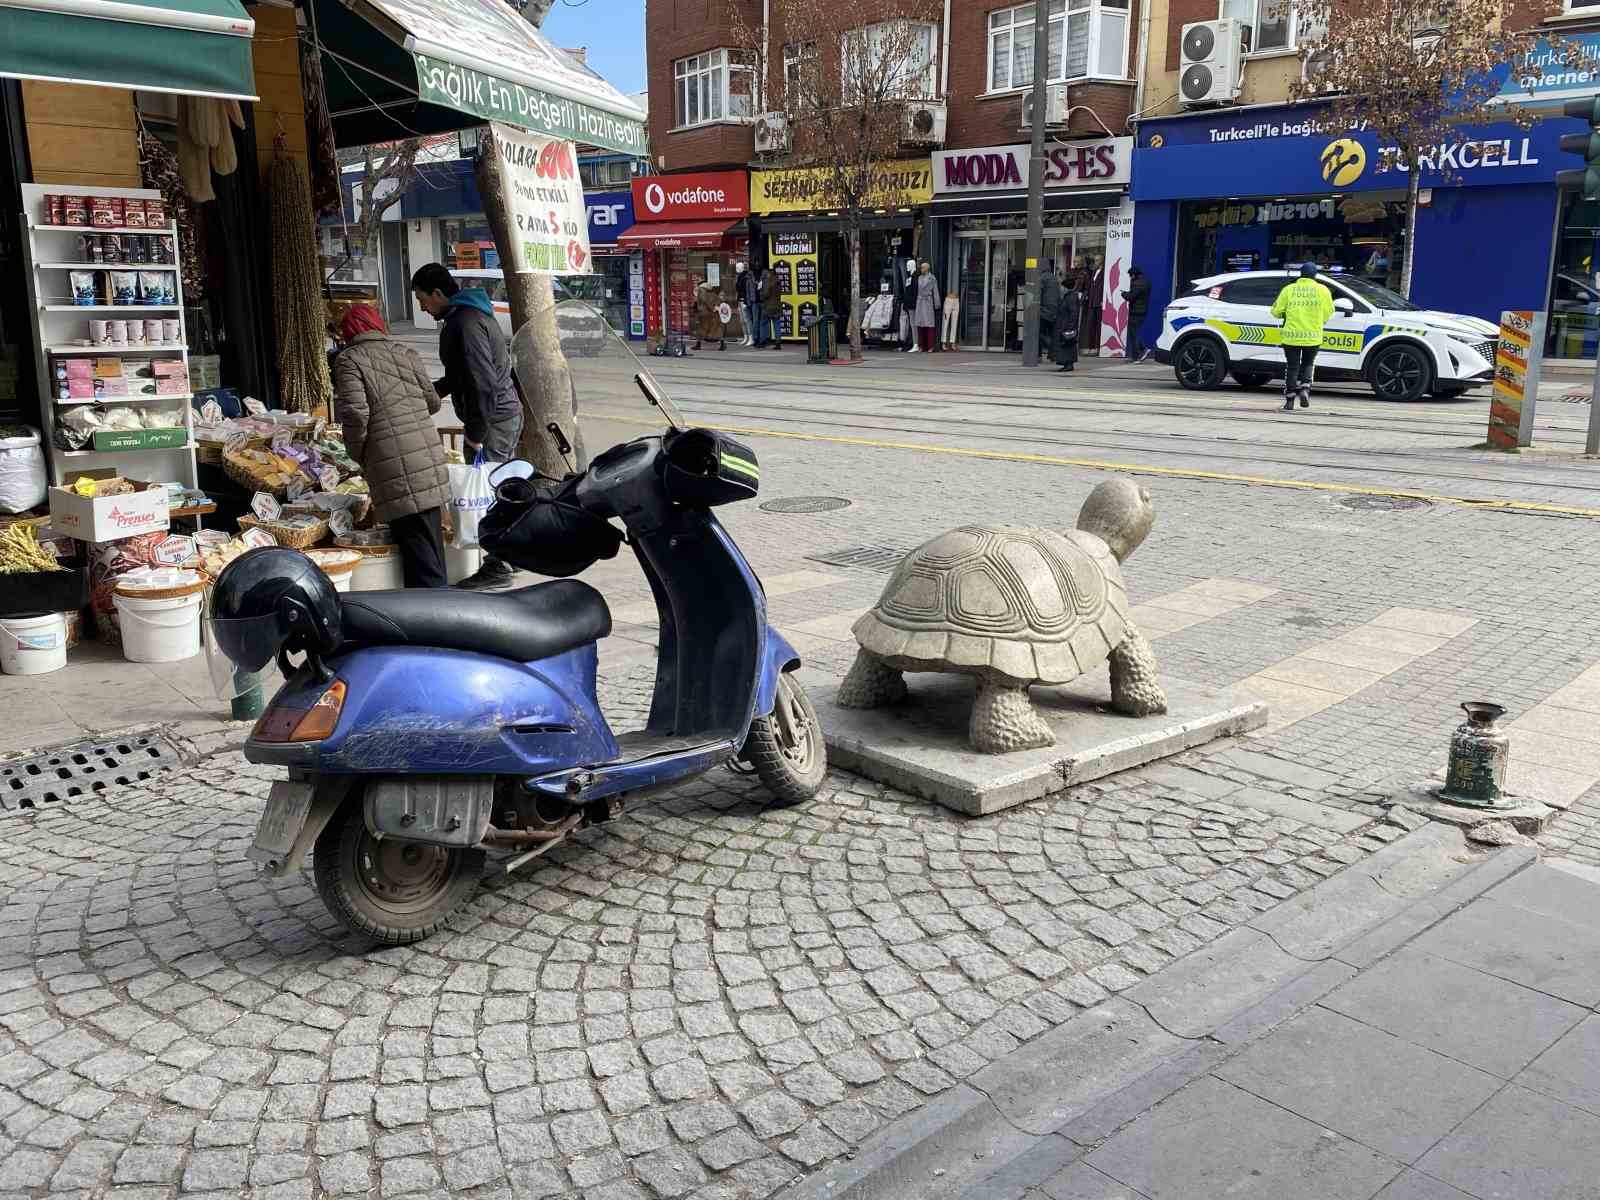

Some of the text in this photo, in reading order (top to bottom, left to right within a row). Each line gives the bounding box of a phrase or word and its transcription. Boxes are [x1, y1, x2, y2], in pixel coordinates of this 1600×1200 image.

[418, 55, 484, 106] Sağlık
[489, 76, 512, 113] En
[515, 85, 575, 129] Değerli
[1209, 124, 1279, 142] Turkcell'le
[944, 152, 1023, 187] MODA
[666, 187, 725, 204] vodafone
[548, 210, 560, 235] 5
[1109, 215, 1132, 227] Bayan
[1109, 230, 1130, 241] Giyim
[775, 240, 812, 254] İNDİRİMİ
[1322, 335, 1356, 348] POLİSİ
